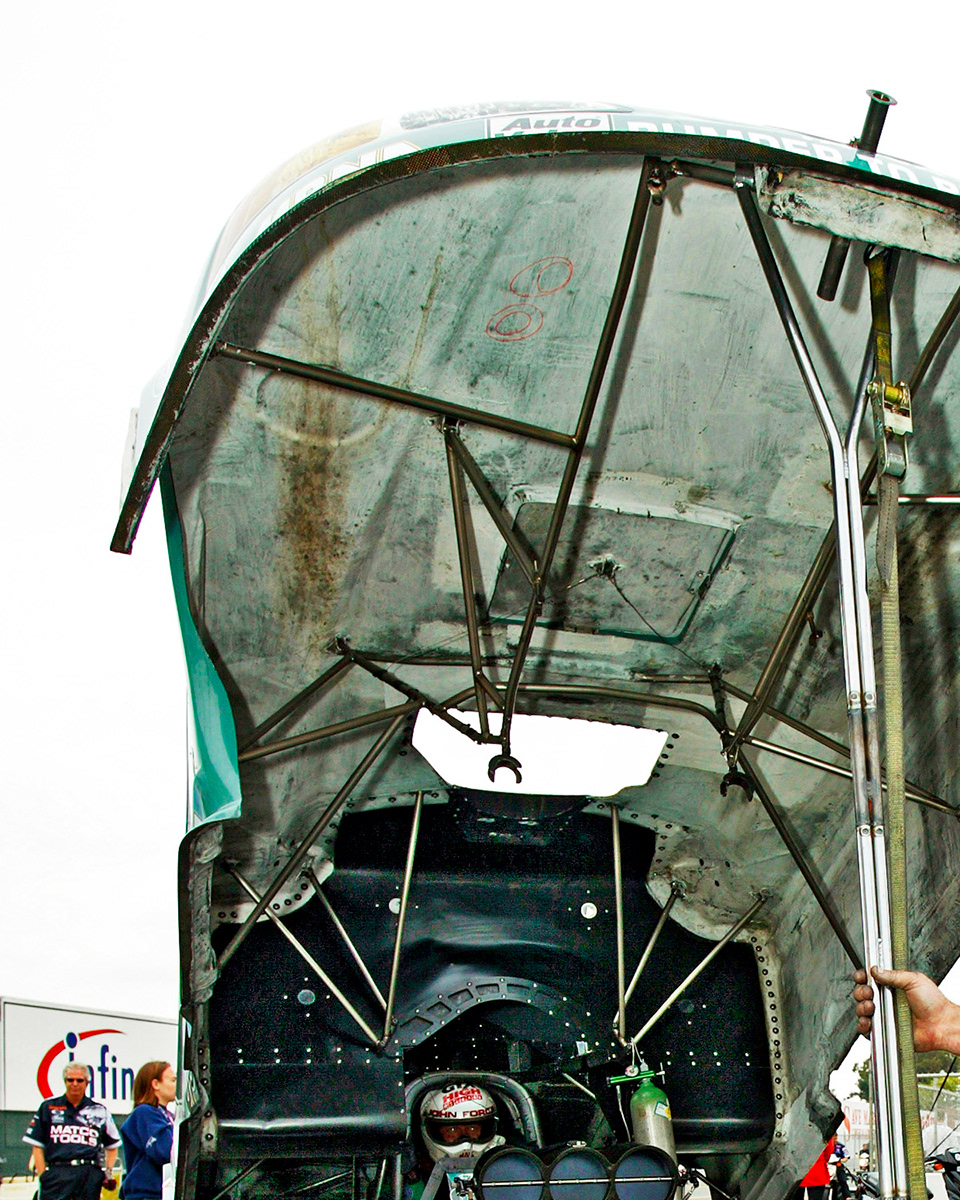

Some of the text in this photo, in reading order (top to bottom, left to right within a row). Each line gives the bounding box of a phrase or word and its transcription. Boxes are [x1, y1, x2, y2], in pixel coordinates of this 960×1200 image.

[502, 116, 601, 131] Auto
[442, 1088, 482, 1105] HIGH
[429, 1109, 457, 1118] JOHN
[50, 1125, 99, 1138] MATCO
[50, 1133, 98, 1147] TOOLS
